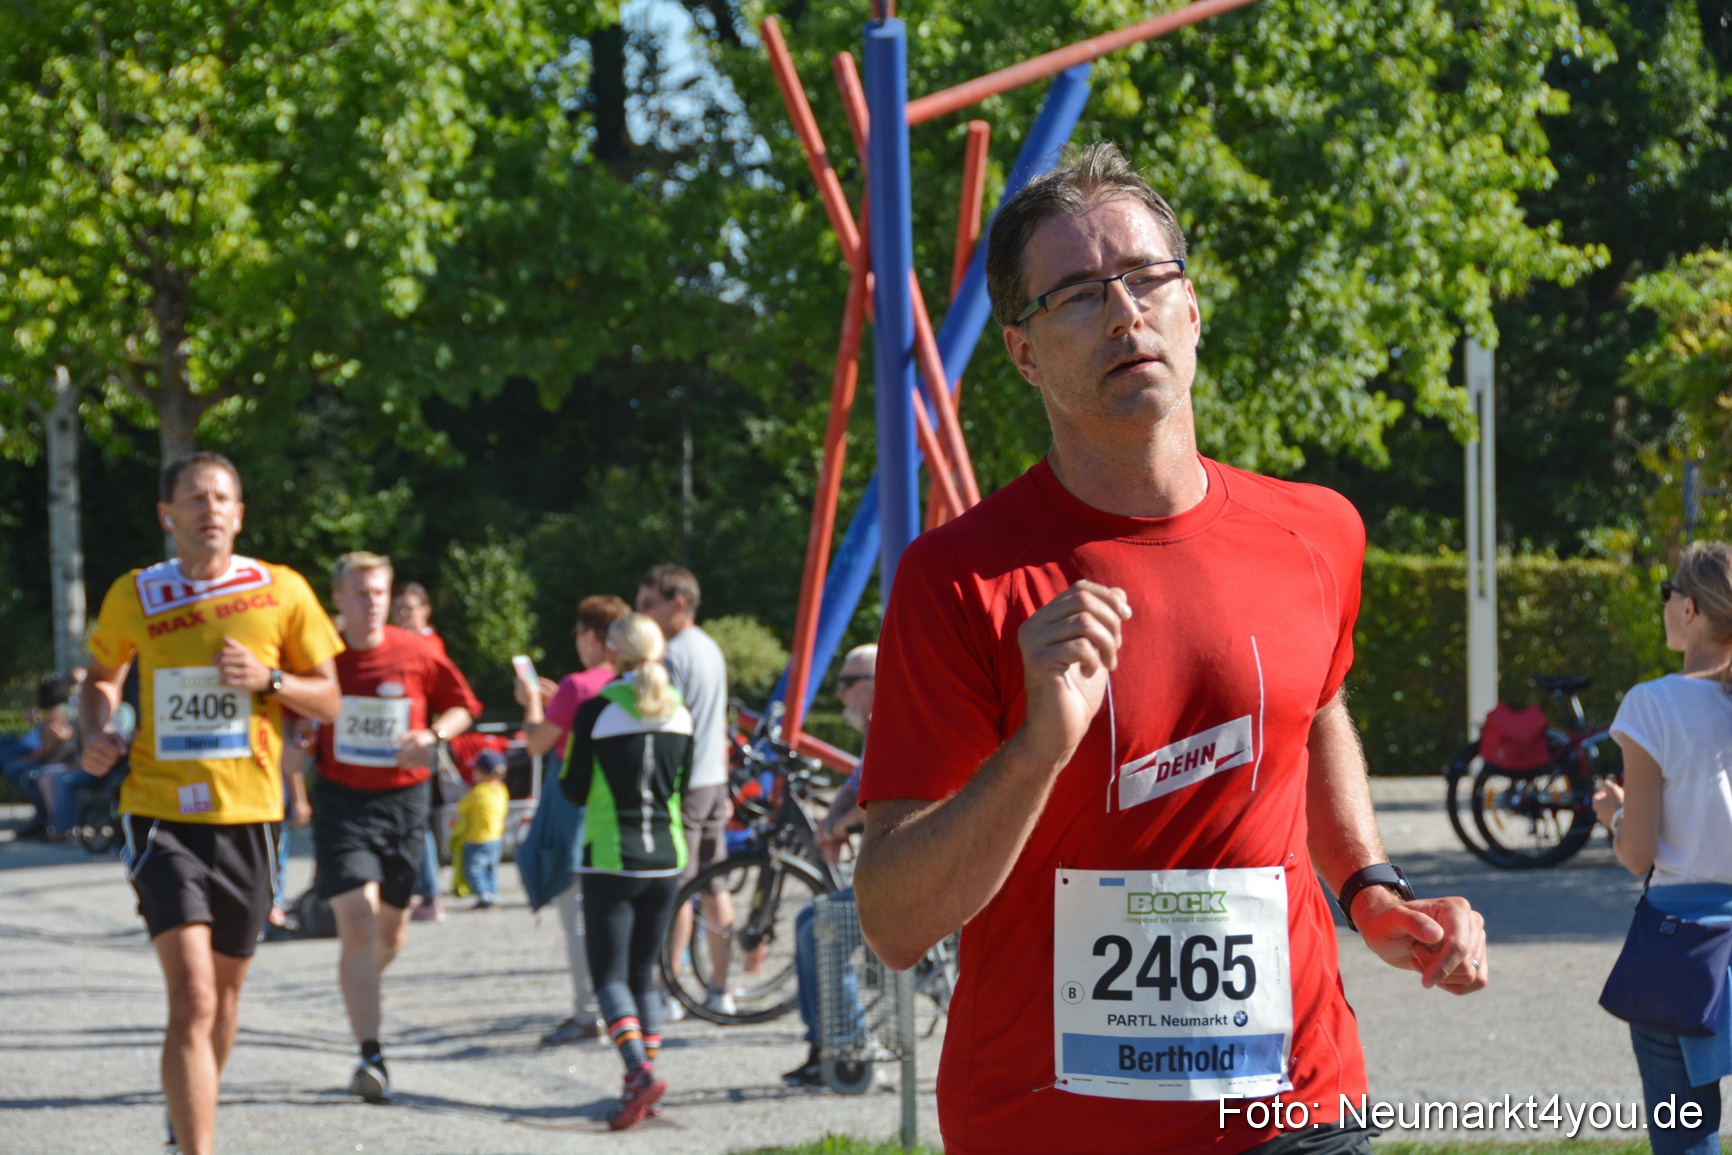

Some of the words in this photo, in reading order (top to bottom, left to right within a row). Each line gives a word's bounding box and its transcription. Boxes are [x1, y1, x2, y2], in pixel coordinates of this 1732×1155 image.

[147, 611, 207, 638] MAX
[214, 592, 279, 619] BÖGL
[168, 693, 237, 721] 2406
[347, 716, 397, 737] 2487
[1155, 742, 1217, 784] DEHN
[1127, 891, 1228, 915] BOCK
[1127, 916, 1159, 924] inspired
[1196, 916, 1229, 924] concepts
[1092, 934, 1256, 1002] 2465
[1068, 987, 1077, 999] B
[1107, 1014, 1157, 1027] PARTL
[1161, 1014, 1228, 1027] Neumarkt
[1118, 1044, 1235, 1072] Berthold
